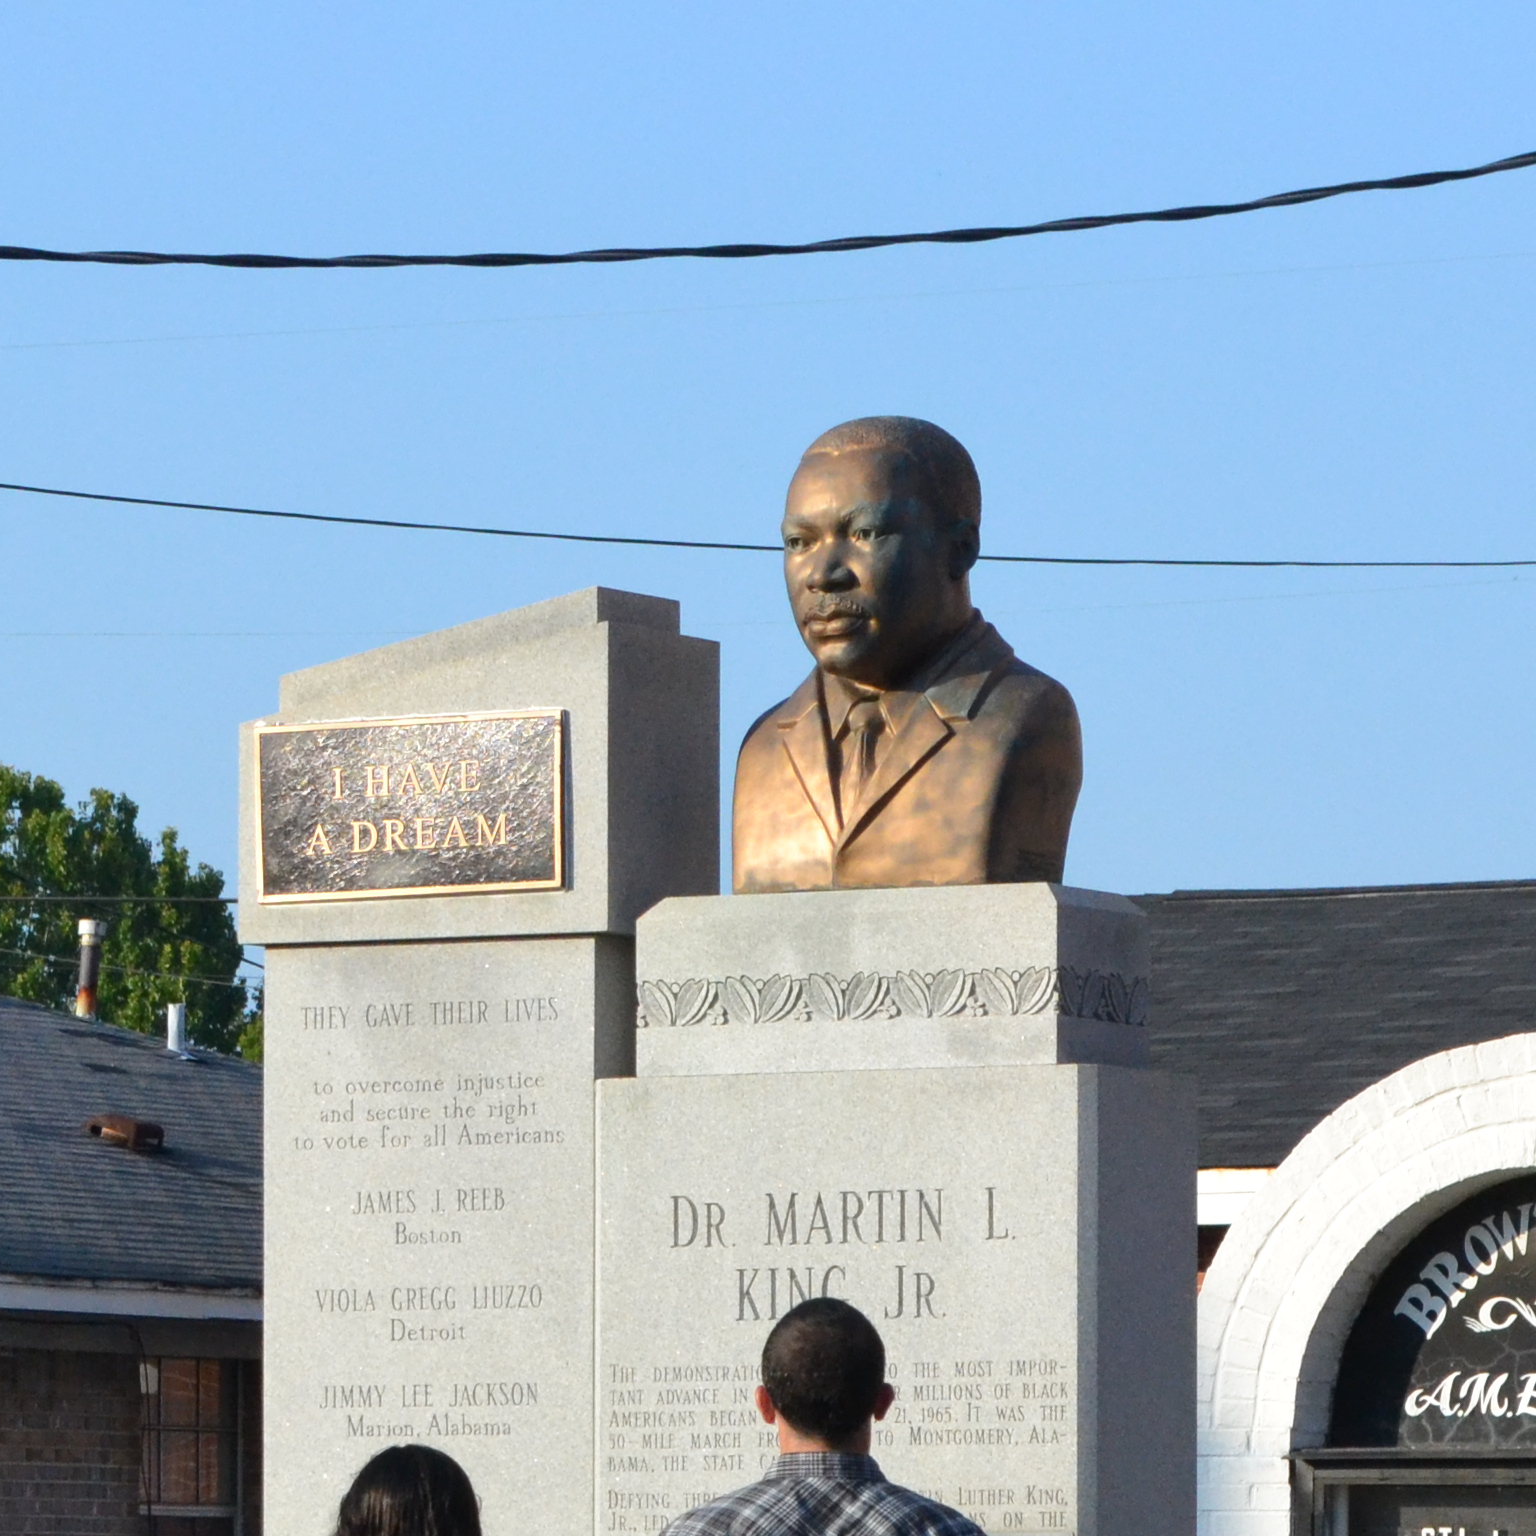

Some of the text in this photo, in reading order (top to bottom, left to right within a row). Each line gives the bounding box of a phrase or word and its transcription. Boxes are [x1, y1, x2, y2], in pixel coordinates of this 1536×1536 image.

[332, 759, 482, 801] I HAVE
[306, 813, 509, 857] A DREAM
[300, 997, 559, 1032] THEY GAVE THEIR LIVES
[313, 1072, 545, 1098] to overcome injustice
[320, 1094, 539, 1124] and secure the right
[294, 1123, 566, 1152] to vote for all Americans
[352, 1187, 506, 1216] JAMES J. REEB
[763, 1188, 944, 1247] MARTIN
[984, 1186, 1017, 1242] L.
[394, 1221, 462, 1246] Boston
[315, 1284, 543, 1313] VIOLA GREGG LIUZZO
[390, 1319, 466, 1343] Detroit
[913, 1361, 940, 1379] THE
[954, 1360, 993, 1378] MOST
[1009, 1359, 1068, 1377] IMPOR-
[319, 1382, 539, 1409] JIMMY LEE JACKSON
[610, 1389, 644, 1406] TANT
[656, 1388, 720, 1405] ADVANCE
[733, 1388, 749, 1403] IN
[913, 1384, 983, 1402] MILLIONS
[994, 1382, 1012, 1400] OF
[1022, 1381, 1069, 1399] BLACK
[346, 1412, 511, 1439] Marion, Alabama
[609, 1410, 696, 1428] AMERICANS
[710, 1410, 757, 1427] BEGAN
[921, 1406, 959, 1424] 1965.
[995, 1405, 1026, 1422] WAS
[1040, 1404, 1068, 1422] THE
[690, 1433, 742, 1449] MARCH
[875, 1429, 894, 1447] TO
[909, 1425, 1019, 1447] MONTGOMERY,
[608, 1456, 655, 1473] BAMA,
[662, 1456, 689, 1472] THE
[703, 1455, 745, 1471] STATE
[608, 1490, 671, 1509] DEFYING
[958, 1486, 1015, 1506] LUTHER
[1027, 1485, 1068, 1506] KING,
[644, 1515, 669, 1531] LED
[1003, 1512, 1023, 1528] ON
[1039, 1511, 1067, 1527] THE
